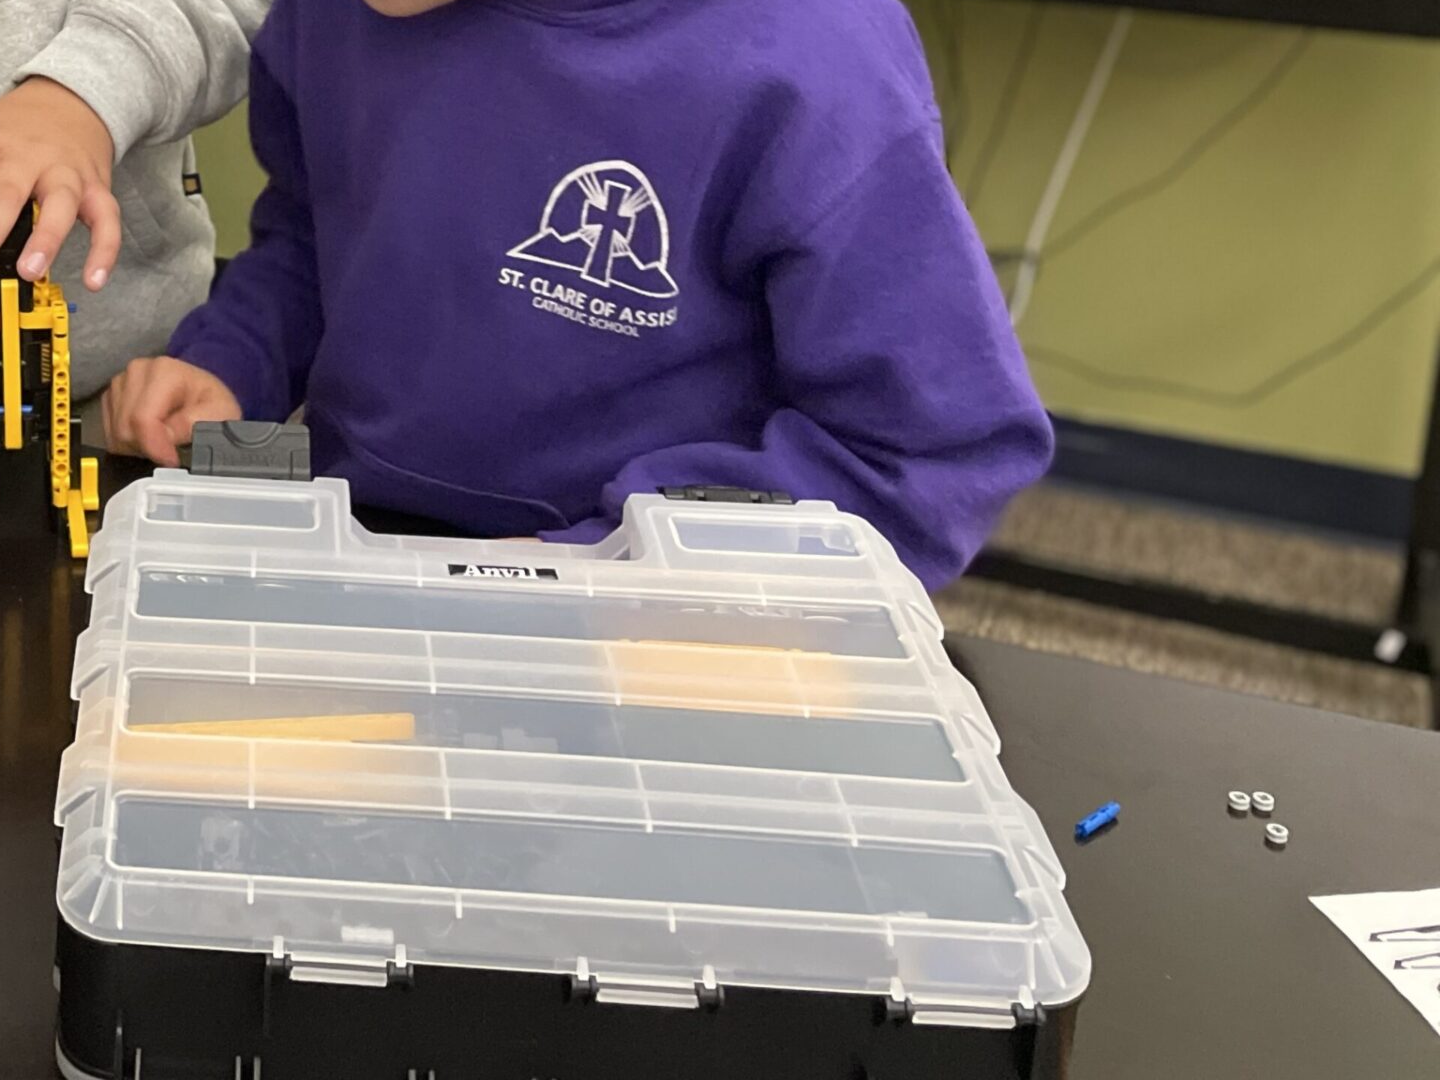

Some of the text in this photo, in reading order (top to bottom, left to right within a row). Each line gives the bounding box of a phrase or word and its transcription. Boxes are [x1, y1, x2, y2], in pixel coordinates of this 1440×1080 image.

[498, 267, 526, 289] ST.
[530, 276, 588, 310] CLARE
[589, 297, 617, 318] OF
[532, 295, 640, 337] CATHOLIC SCHOOL
